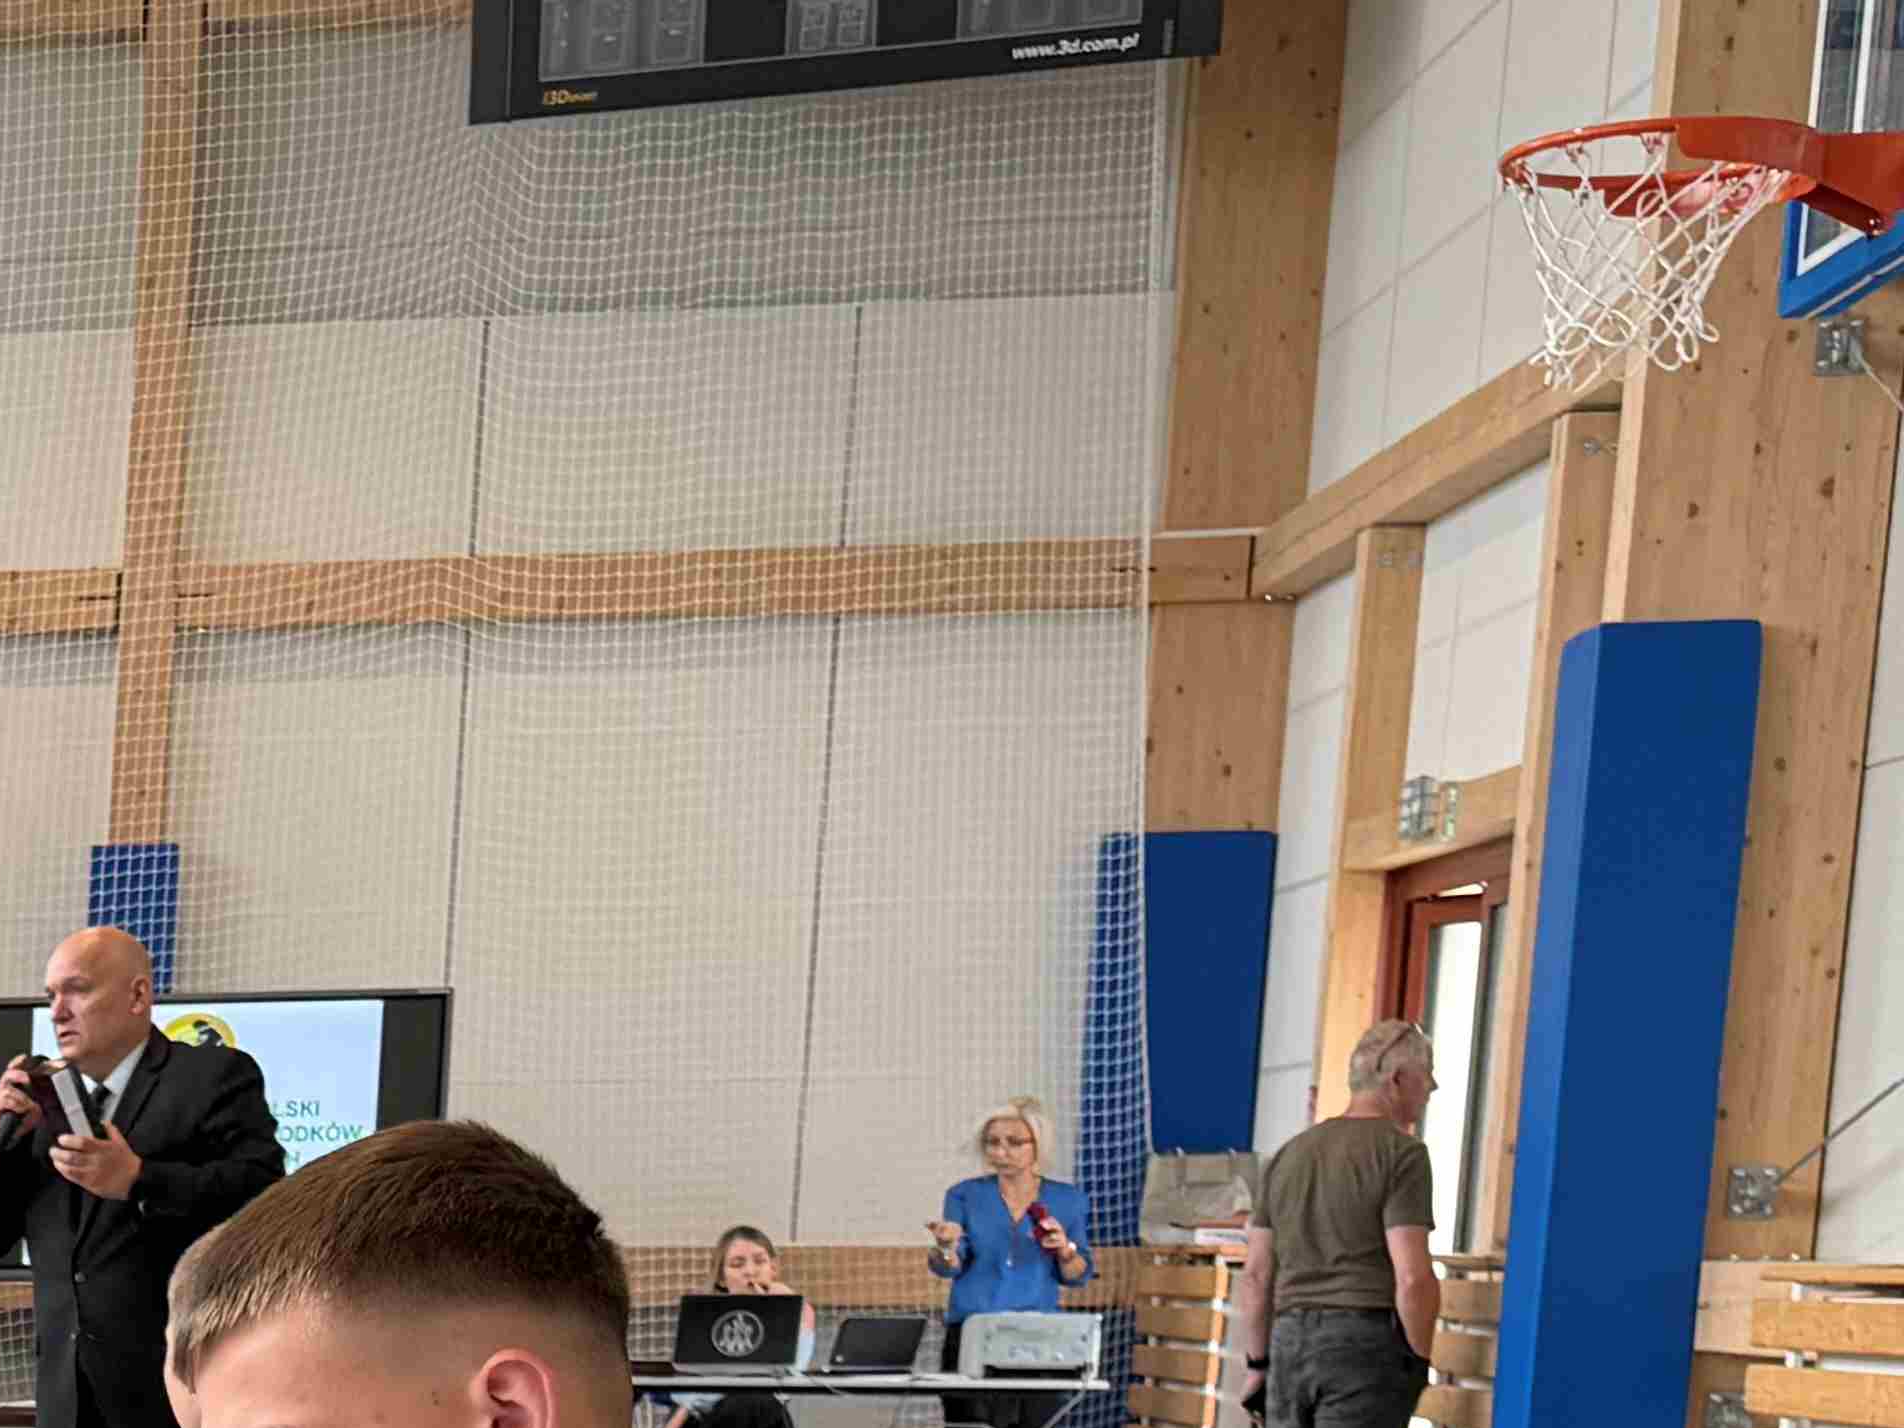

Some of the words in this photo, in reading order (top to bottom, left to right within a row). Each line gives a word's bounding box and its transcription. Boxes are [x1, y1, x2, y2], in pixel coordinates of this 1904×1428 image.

[1012, 32, 1140, 60] www.3d.com.pl
[272, 1099, 320, 1118] LSKI
[279, 1119, 364, 1142] ODKÓW
